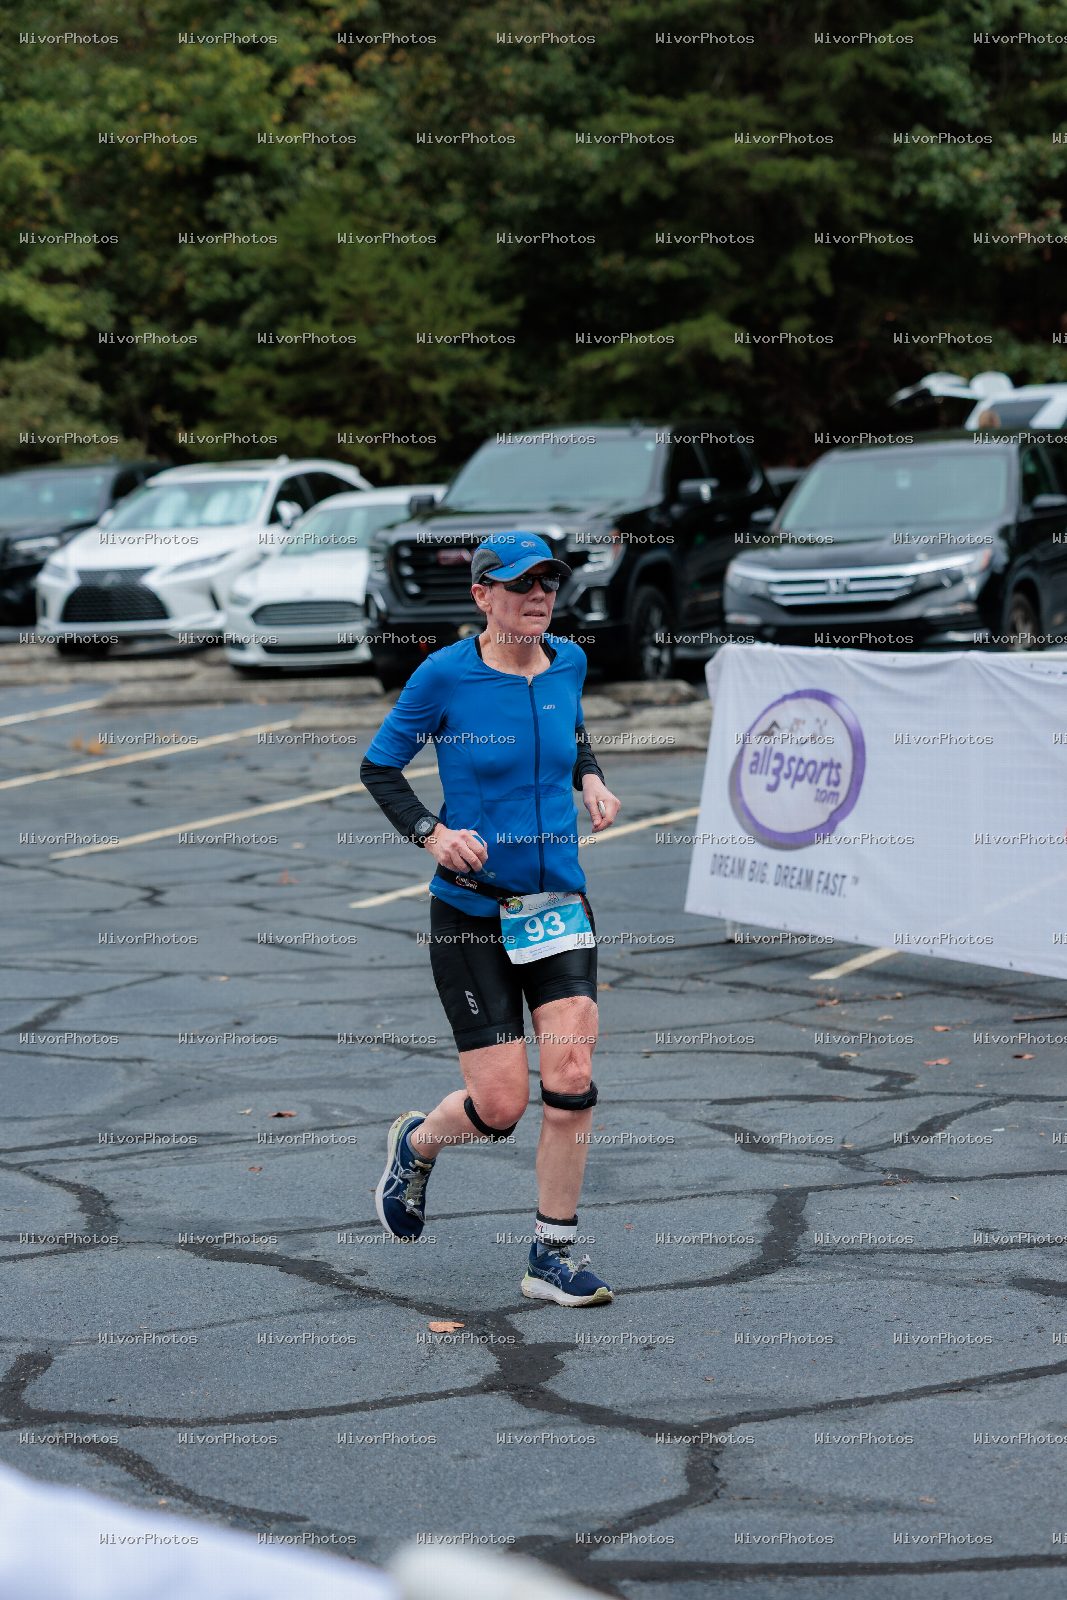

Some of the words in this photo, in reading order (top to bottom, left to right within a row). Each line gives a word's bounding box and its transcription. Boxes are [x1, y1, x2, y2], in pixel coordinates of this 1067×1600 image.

[749, 746, 842, 793] all3sports
[710, 853, 746, 881] DREAM
[747, 860, 770, 886] BIG.
[774, 863, 814, 893] DREAM
[815, 870, 847, 898] FAST.
[524, 911, 566, 942] 93
